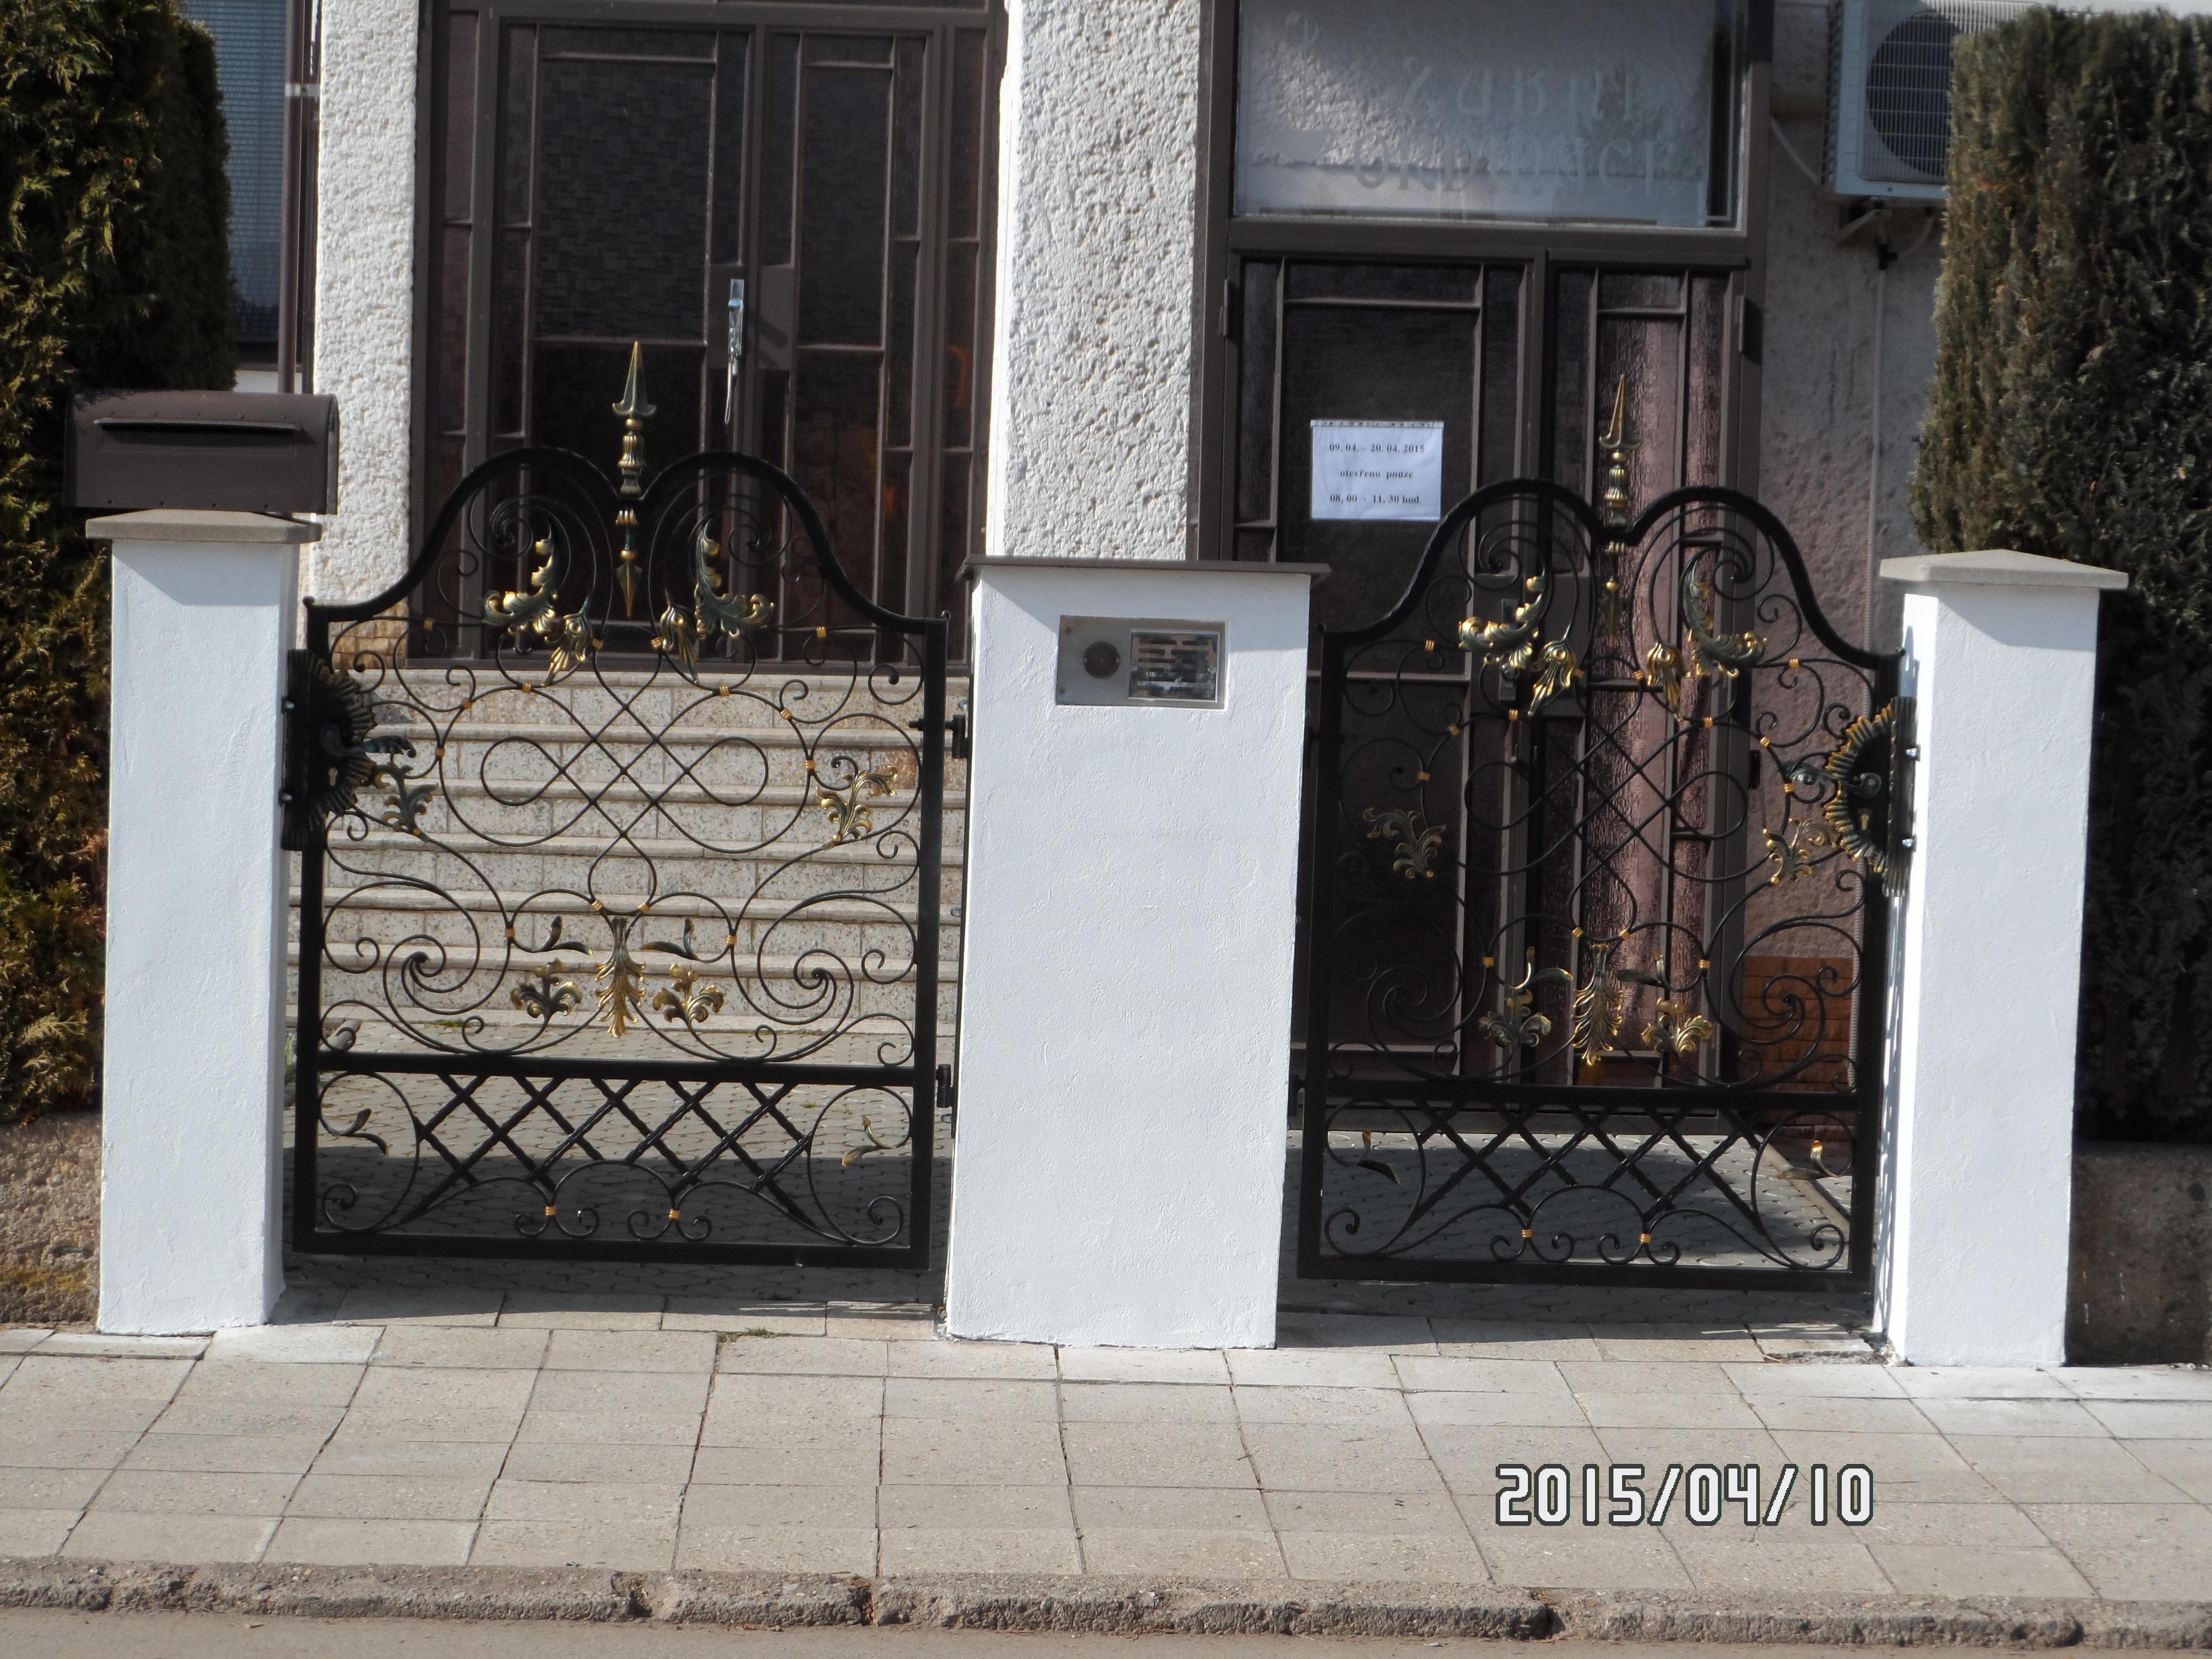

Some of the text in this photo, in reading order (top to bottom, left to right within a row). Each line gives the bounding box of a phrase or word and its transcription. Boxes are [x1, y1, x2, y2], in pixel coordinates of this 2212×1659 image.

[1329, 443, 1342, 451] 09.
[1346, 444, 1359, 452] 04.
[1387, 444, 1400, 452] 04.
[1403, 444, 1425, 453] 2015
[1340, 469, 1414, 479] otevřeno pouze
